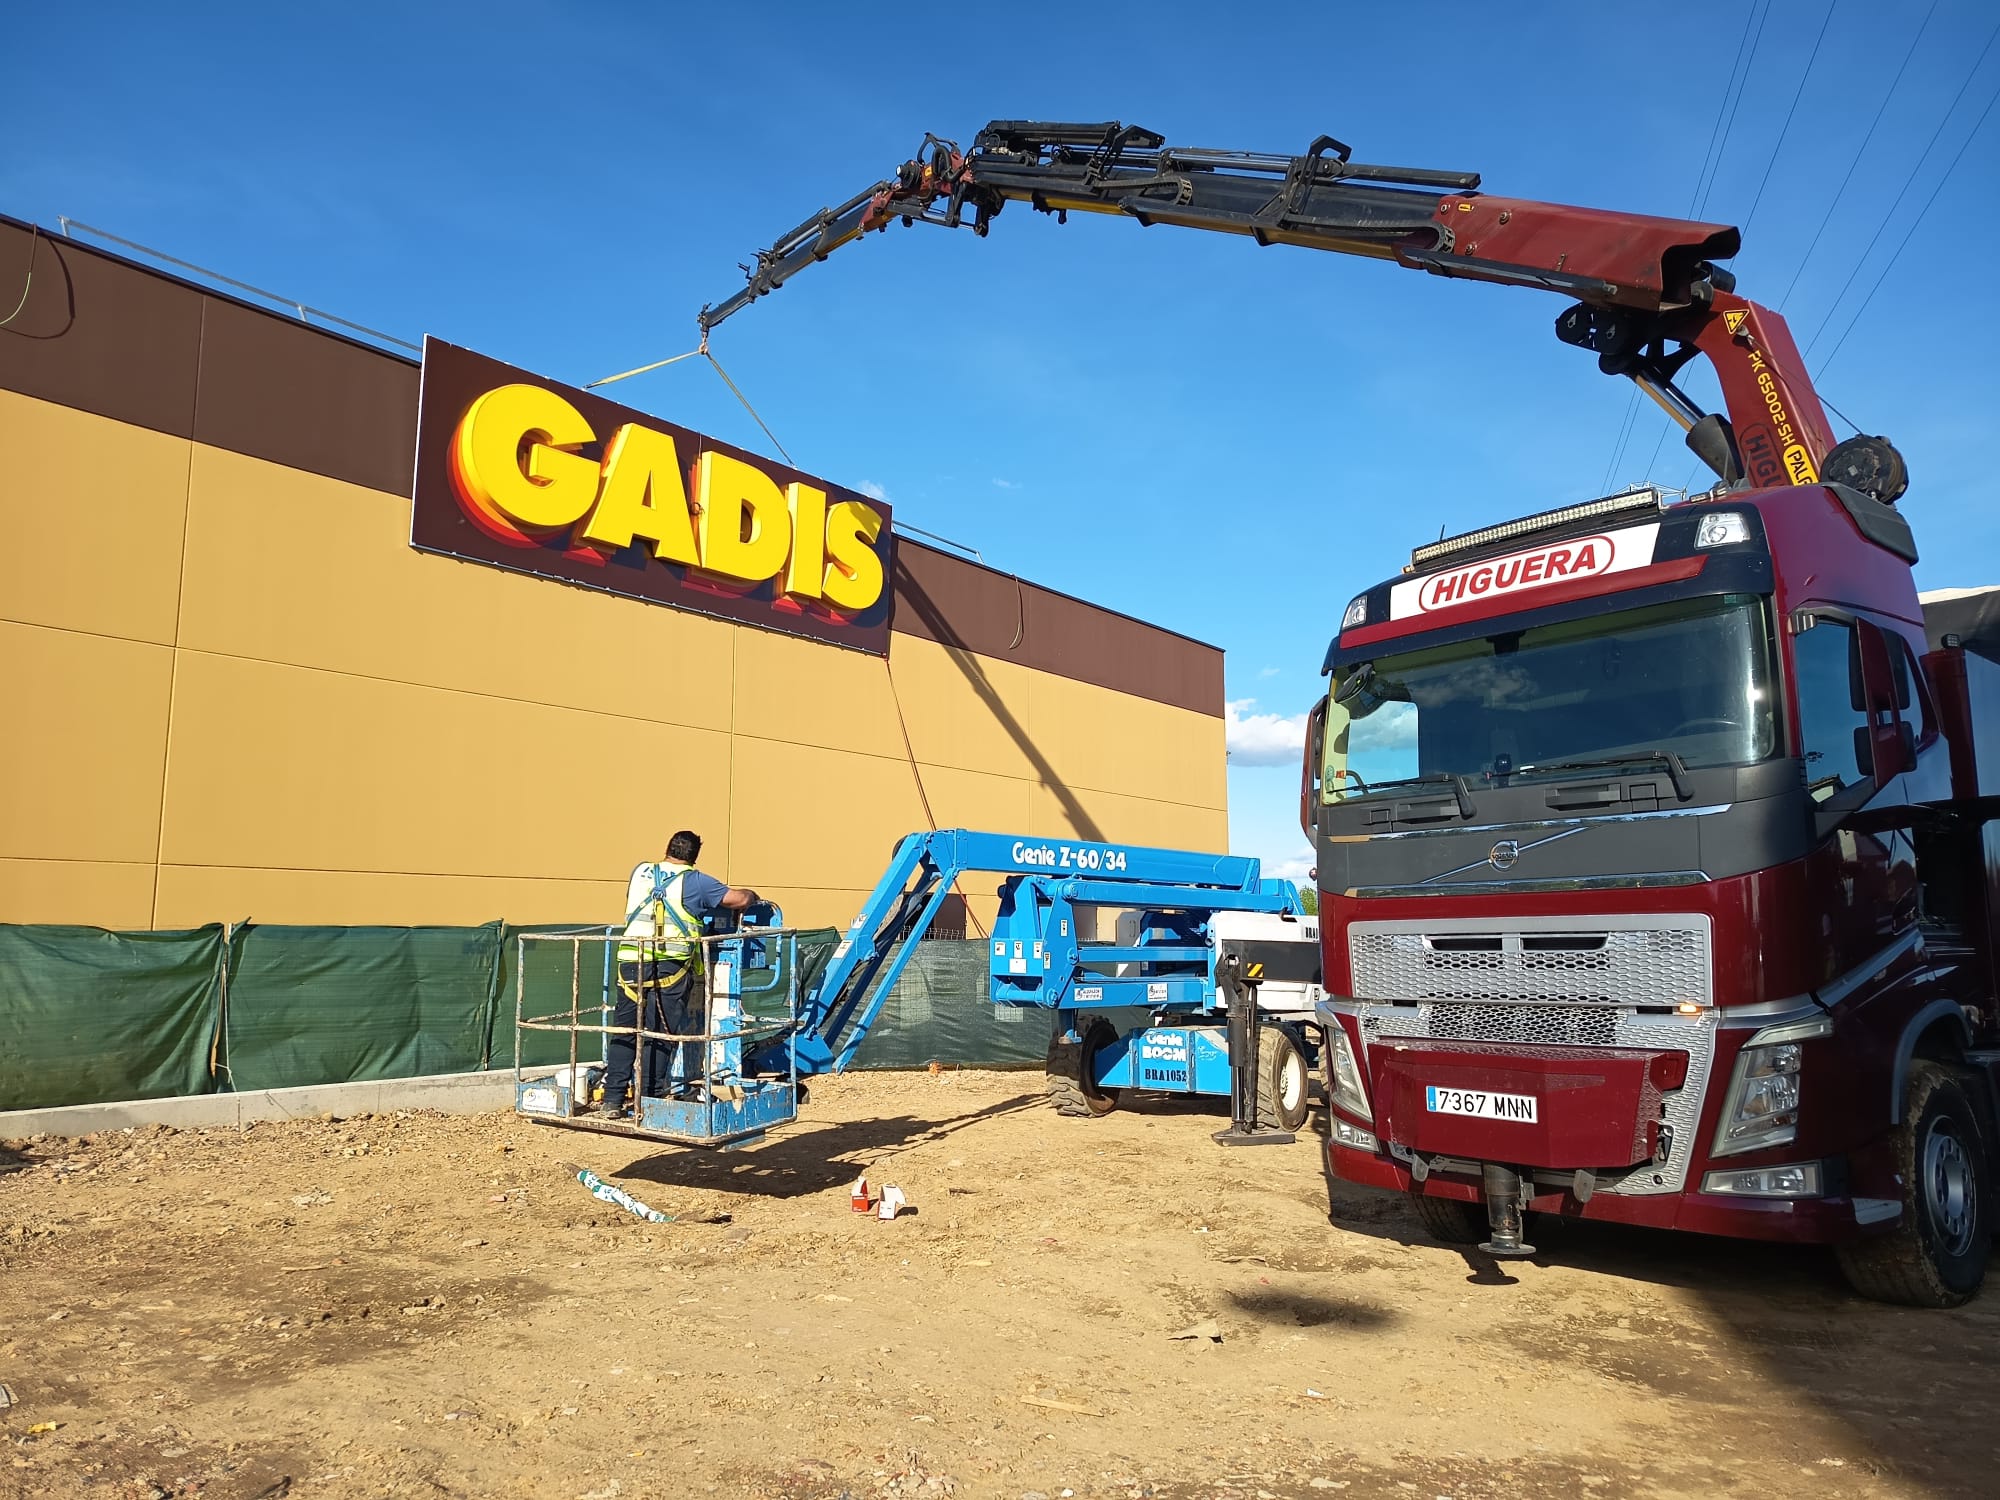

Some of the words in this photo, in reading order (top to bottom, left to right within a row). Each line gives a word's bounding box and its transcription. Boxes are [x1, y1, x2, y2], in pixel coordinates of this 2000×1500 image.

[1748, 350, 1766, 373] PK
[459, 383, 884, 611] GADIS
[1431, 543, 1596, 605] HIGUERA
[1012, 841, 1056, 866] Genie
[1059, 846, 1127, 871] Z-60/34
[1146, 1031, 1183, 1047] Genie
[1142, 1045, 1186, 1062] BOOM
[1145, 1068, 1187, 1082] BRA1052
[1439, 1090, 1486, 1113] 7367
[1494, 1096, 1532, 1119] MNN
